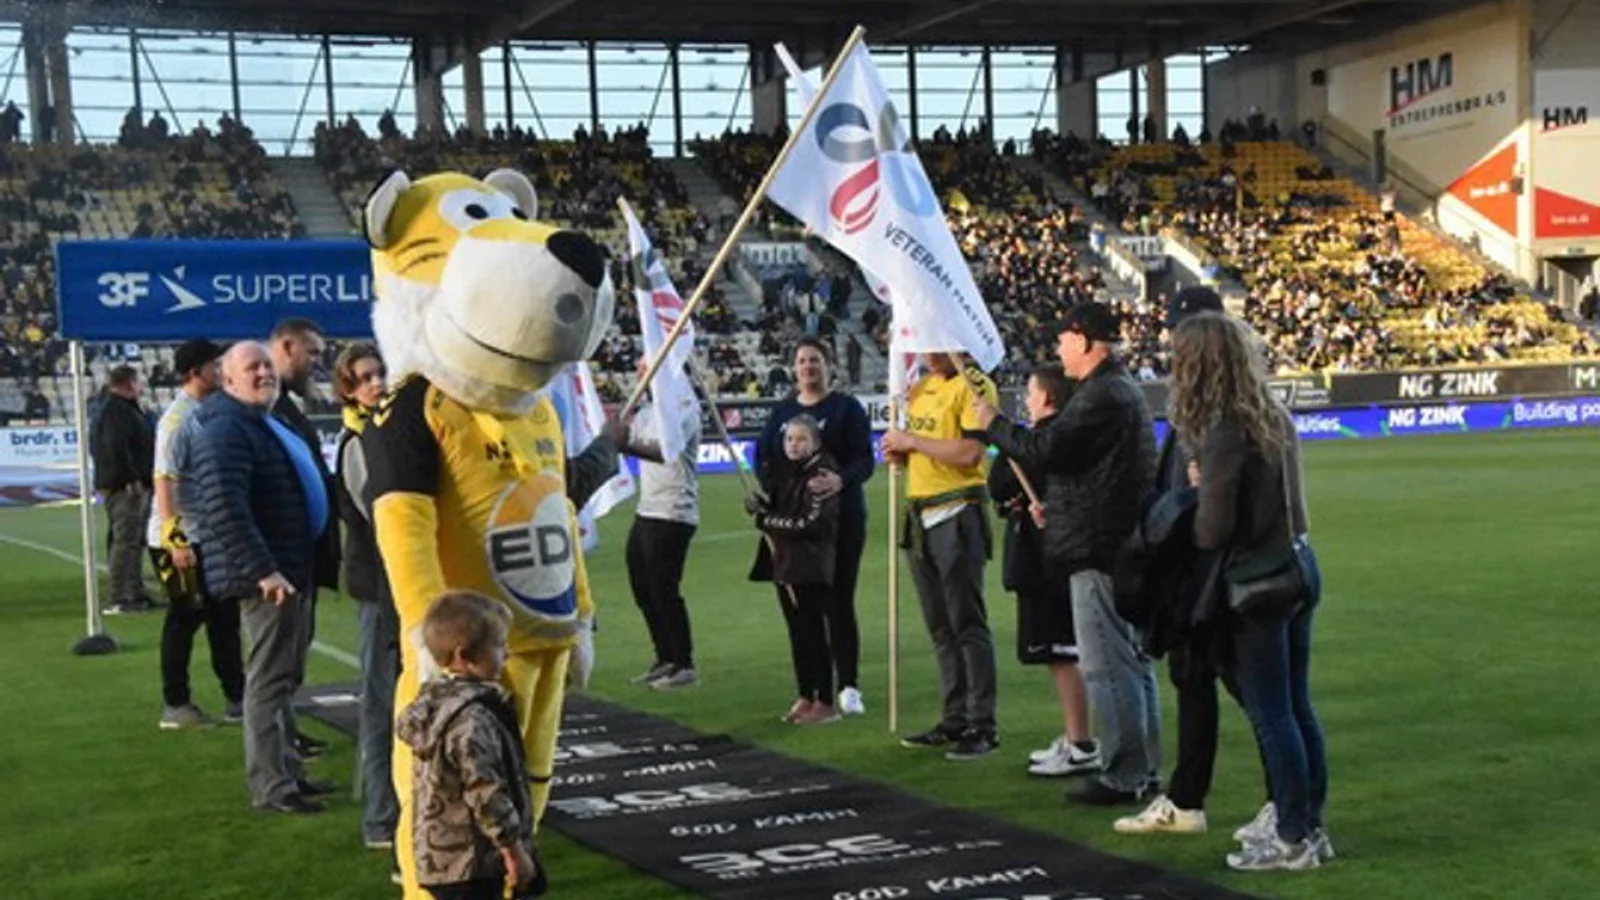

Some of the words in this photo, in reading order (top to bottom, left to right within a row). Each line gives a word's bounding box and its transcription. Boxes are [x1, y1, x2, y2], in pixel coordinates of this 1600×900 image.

[1389, 52, 1453, 112] HM
[1542, 106, 1588, 132] HM
[884, 221, 953, 290] VETERAN
[97, 271, 150, 307] 3F
[211, 272, 372, 304] SUPERLI
[1400, 375, 1433, 398] NG
[1439, 371, 1499, 395] ZINK
[1388, 408, 1417, 428] NG
[1419, 405, 1470, 425] ZINK
[1514, 401, 1578, 423] Building
[491, 524, 571, 574] ED
